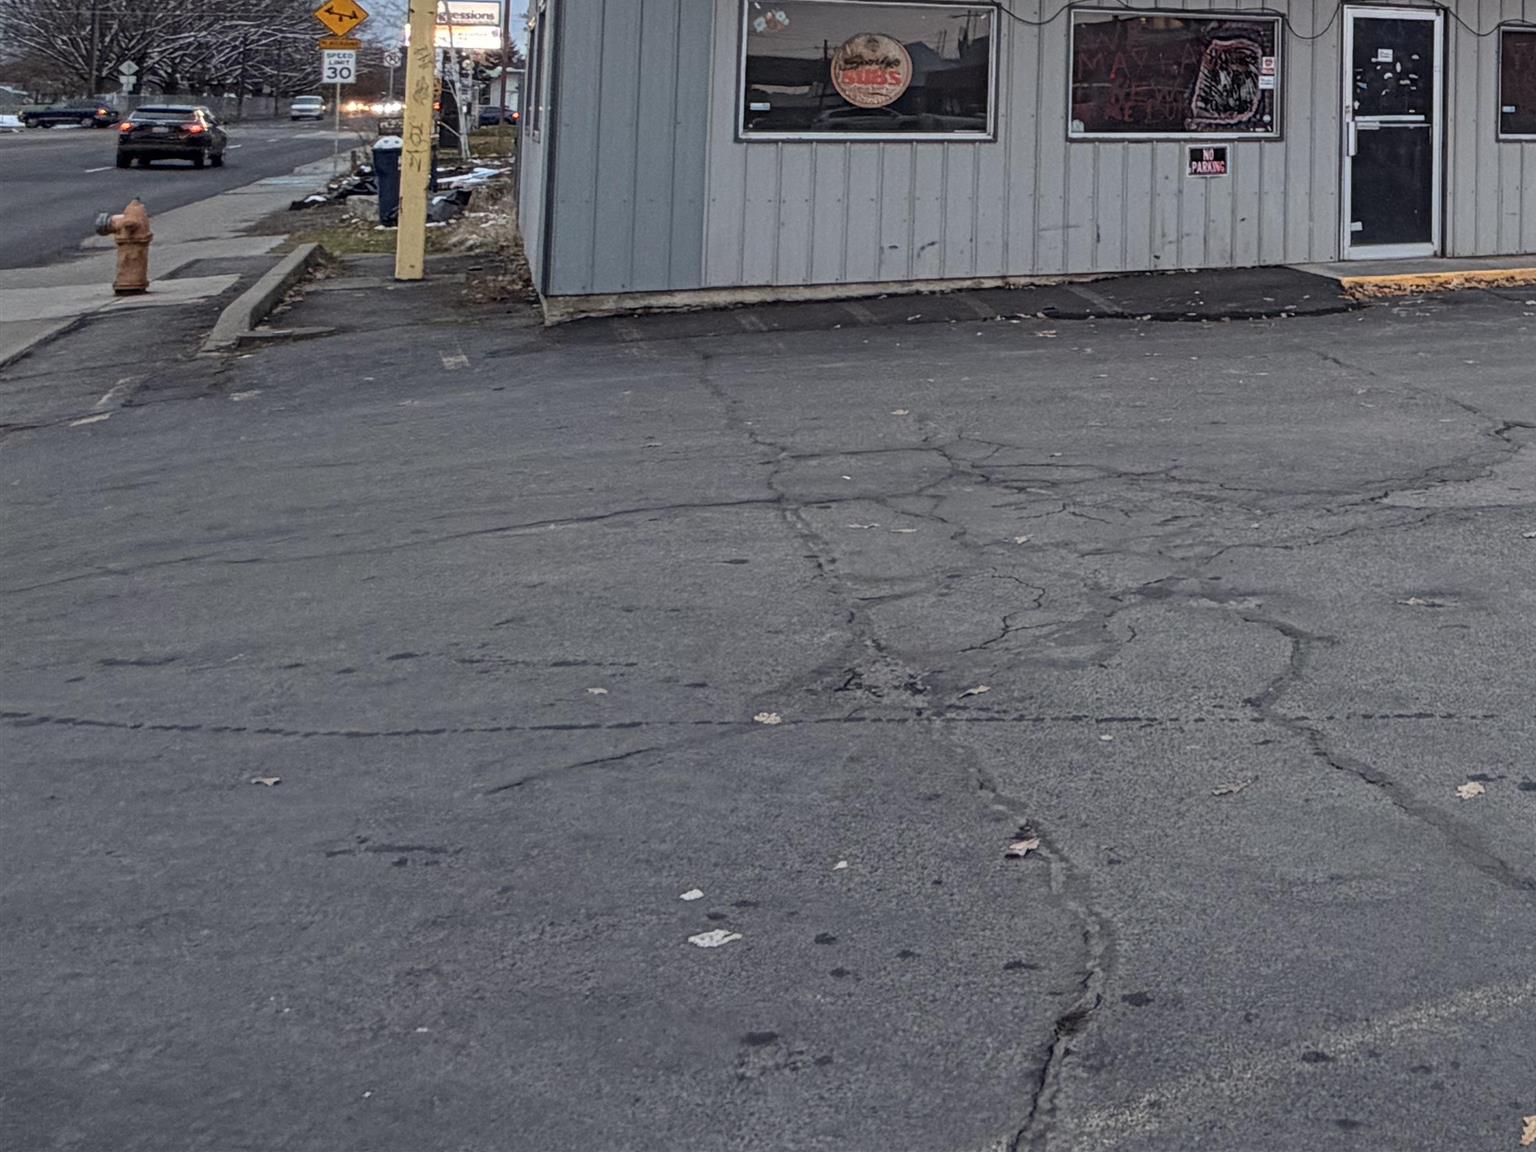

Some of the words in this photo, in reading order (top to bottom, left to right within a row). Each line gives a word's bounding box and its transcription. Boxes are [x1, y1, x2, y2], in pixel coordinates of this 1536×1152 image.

[326, 66, 352, 80] 30
[842, 69, 903, 86] SUBS
[1202, 147, 1215, 161] NO
[1191, 160, 1226, 173] PARKING
